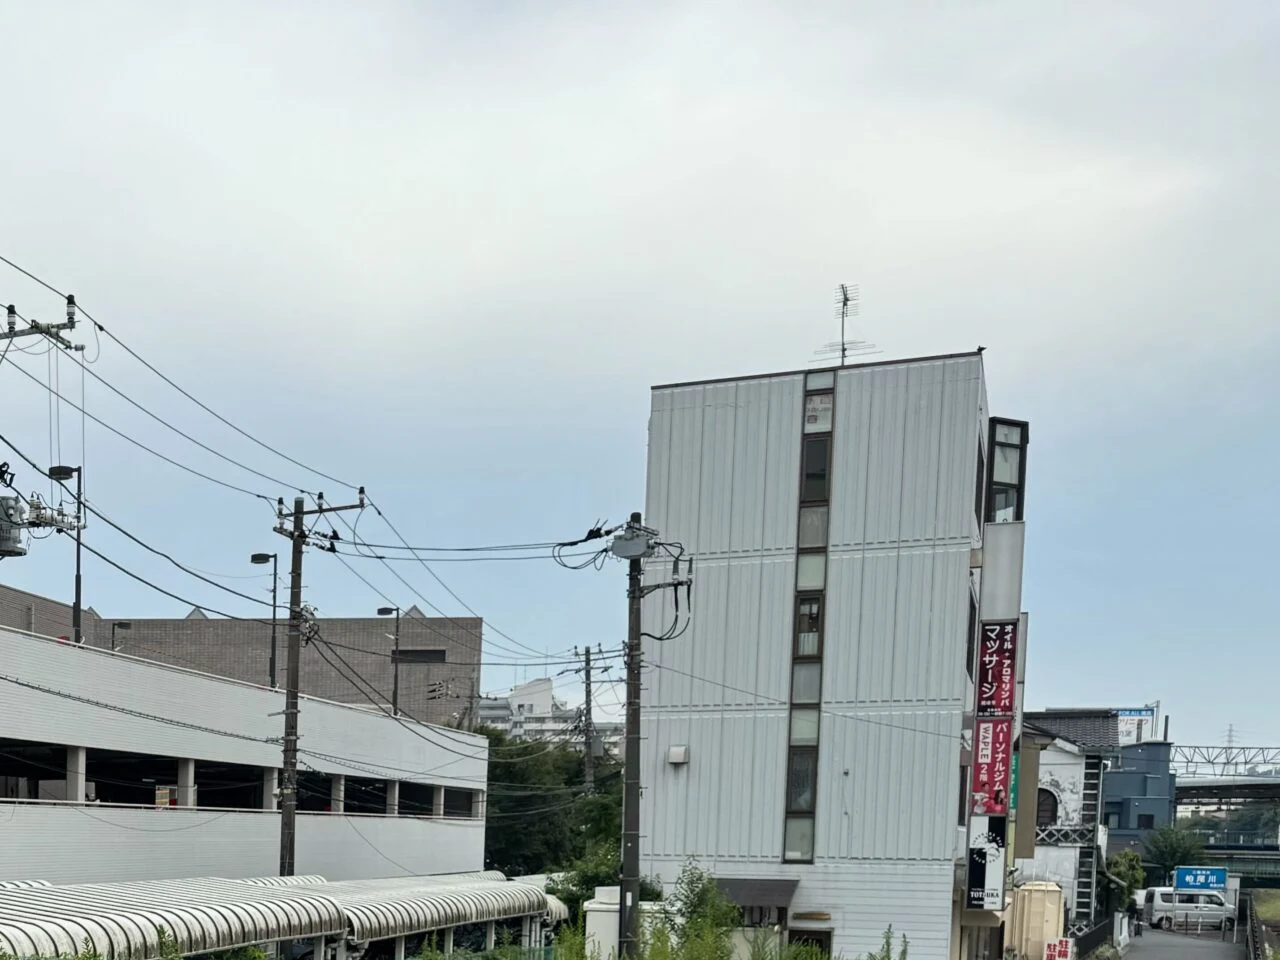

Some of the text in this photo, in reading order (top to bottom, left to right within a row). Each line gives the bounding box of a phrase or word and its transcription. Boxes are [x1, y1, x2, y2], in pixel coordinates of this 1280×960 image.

[981, 625, 1001, 698] マッサージ
[980, 726, 992, 760] WAPLE
[970, 891, 1000, 899] TOTSUKA
